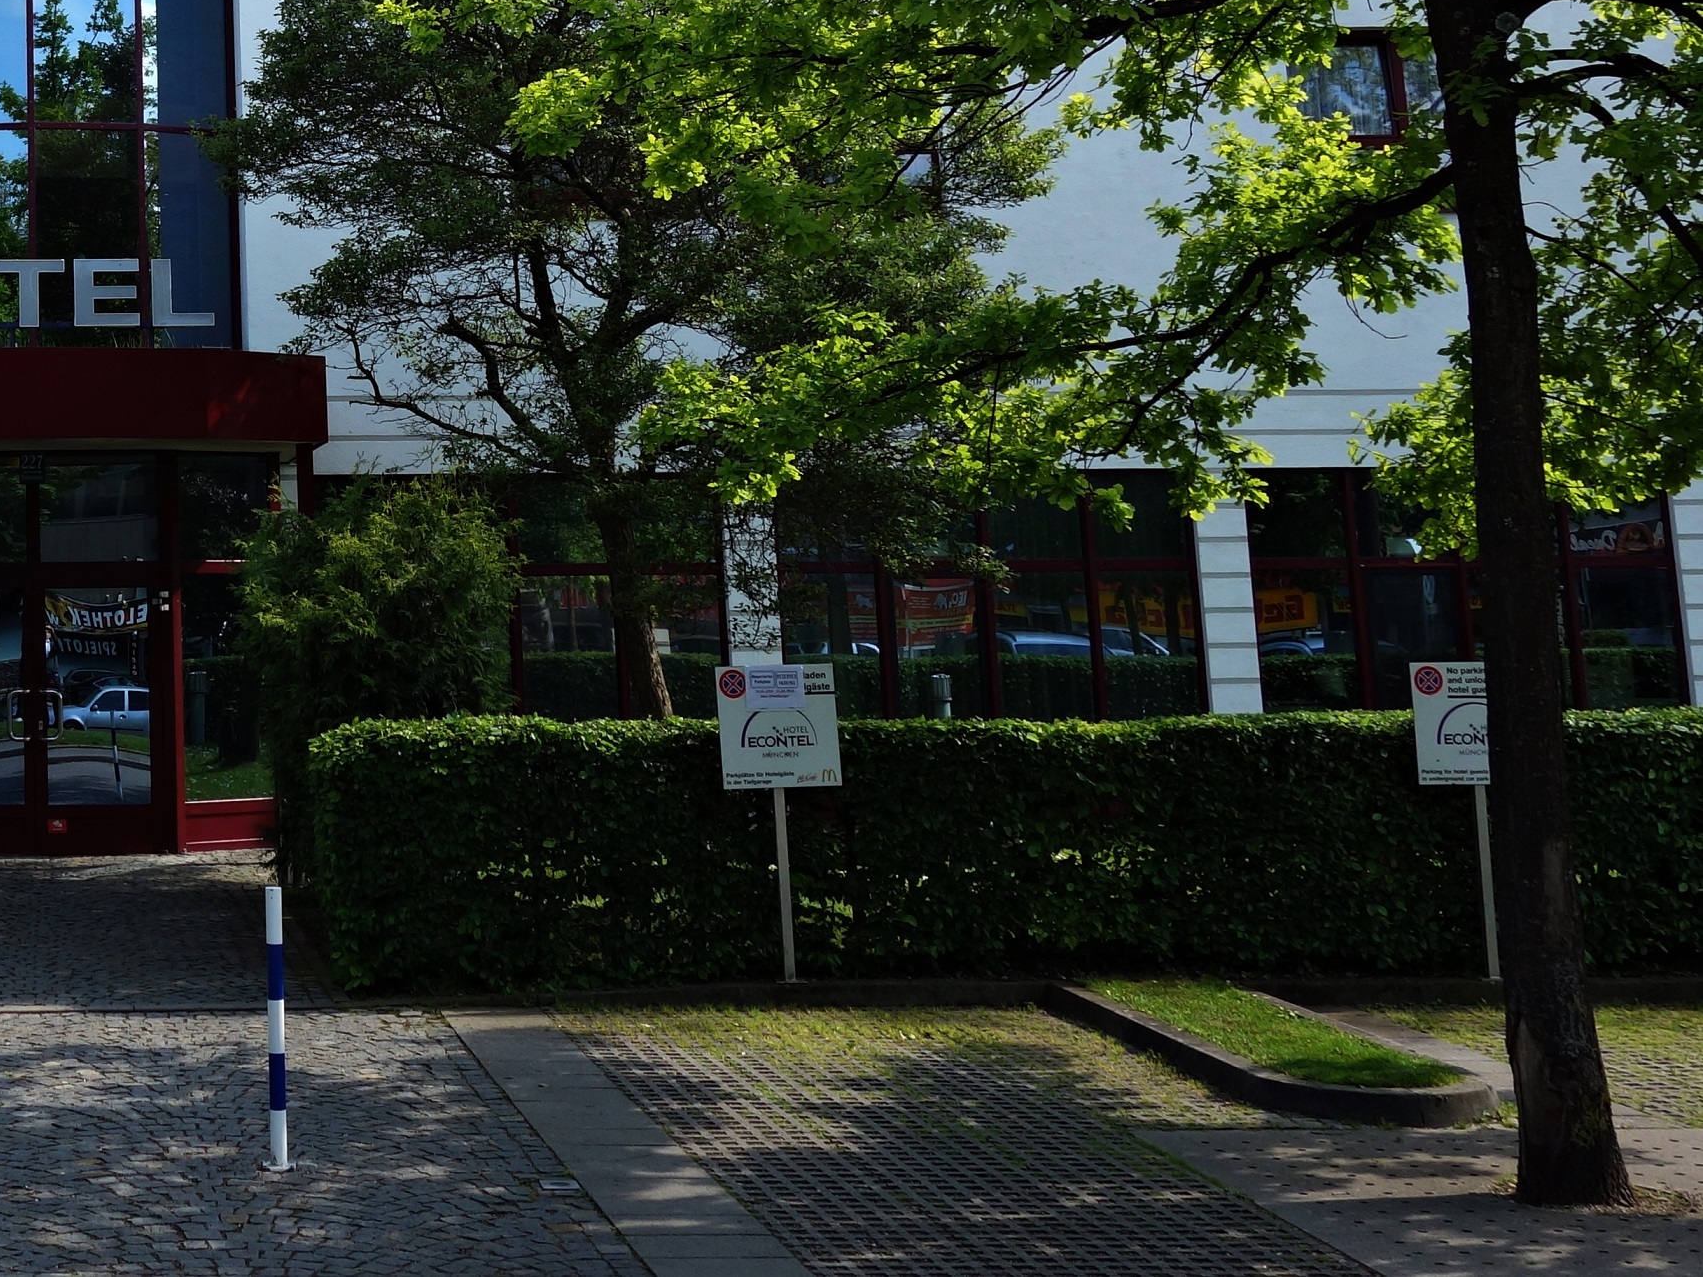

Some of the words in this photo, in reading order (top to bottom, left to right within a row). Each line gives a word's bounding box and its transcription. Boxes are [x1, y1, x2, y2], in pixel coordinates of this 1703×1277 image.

[21, 454, 44, 469] 227
[1460, 667, 1485, 675] parkin
[804, 683, 830, 692] lgäste
[748, 735, 814, 748] ECONTEL
[1444, 733, 1487, 745] ECON
